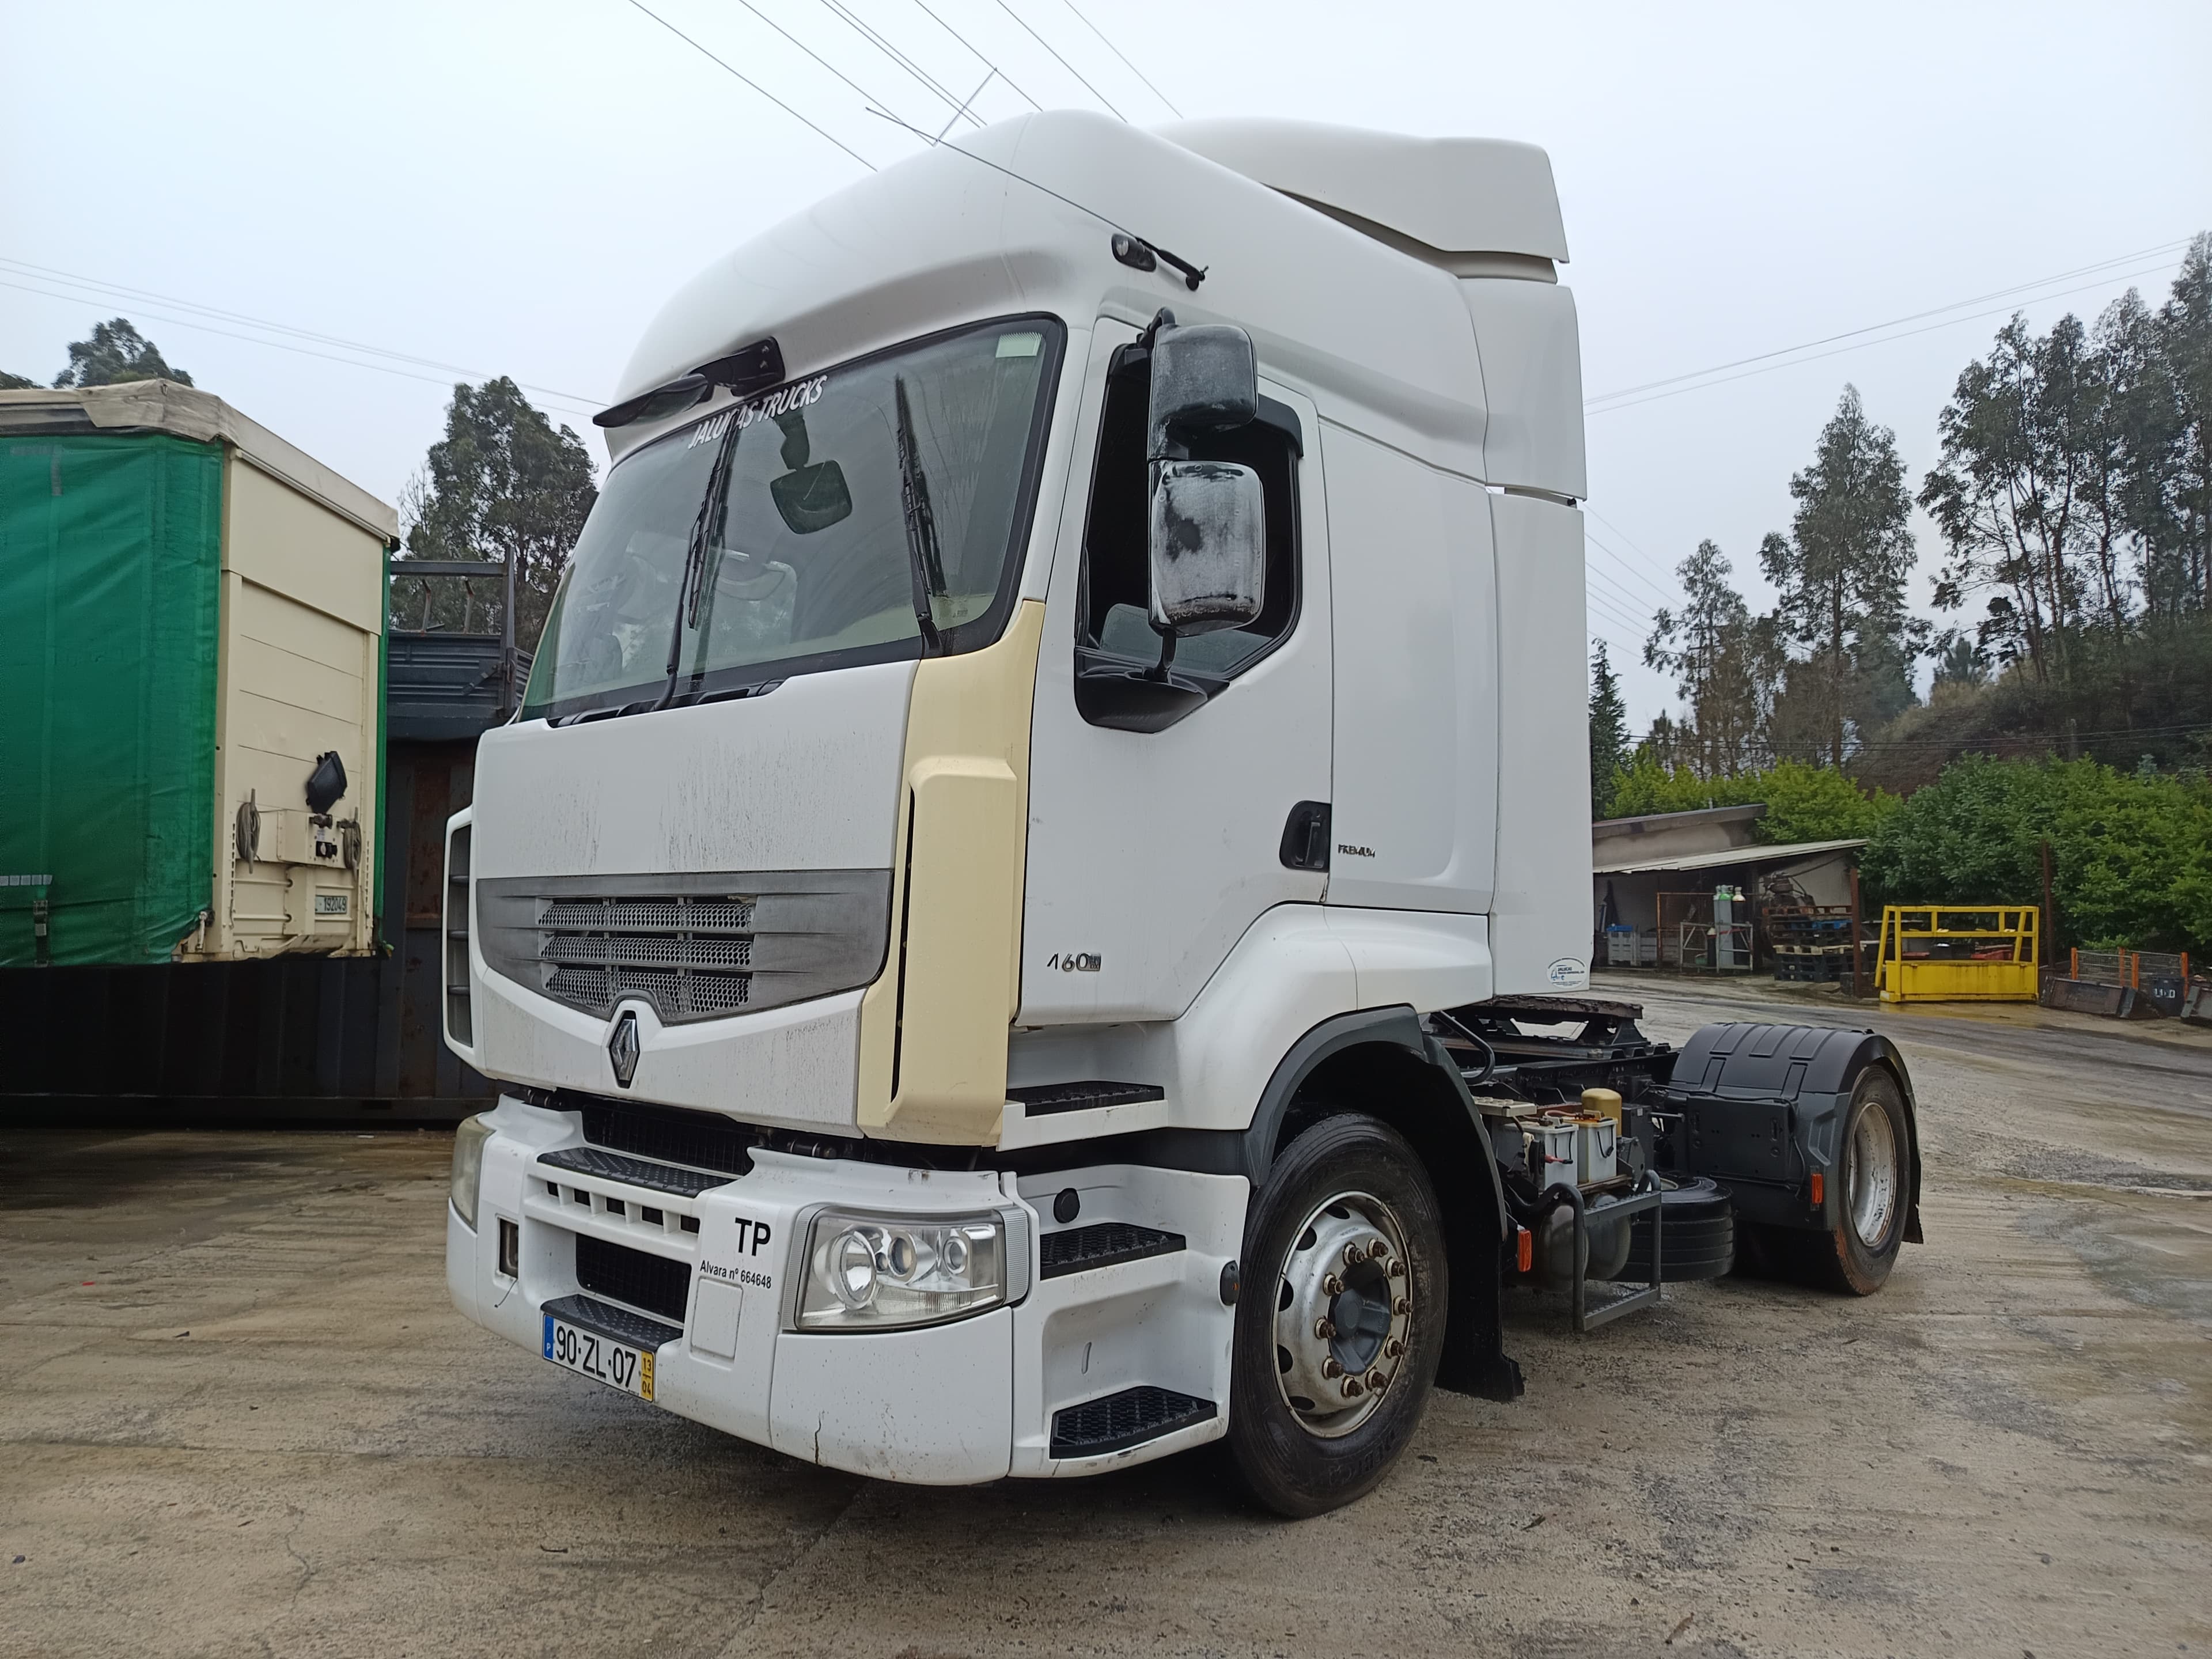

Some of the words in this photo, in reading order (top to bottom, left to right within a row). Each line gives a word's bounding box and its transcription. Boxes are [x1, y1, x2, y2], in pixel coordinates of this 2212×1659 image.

[757, 374, 828, 422] TRUCKS
[734, 1217, 771, 1257] TP
[699, 1259, 727, 1278] Alvara
[740, 1269, 771, 1289] 664648
[547, 1342, 551, 1351] P
[643, 1357, 652, 1372] 13
[642, 1380, 652, 1395] 04
